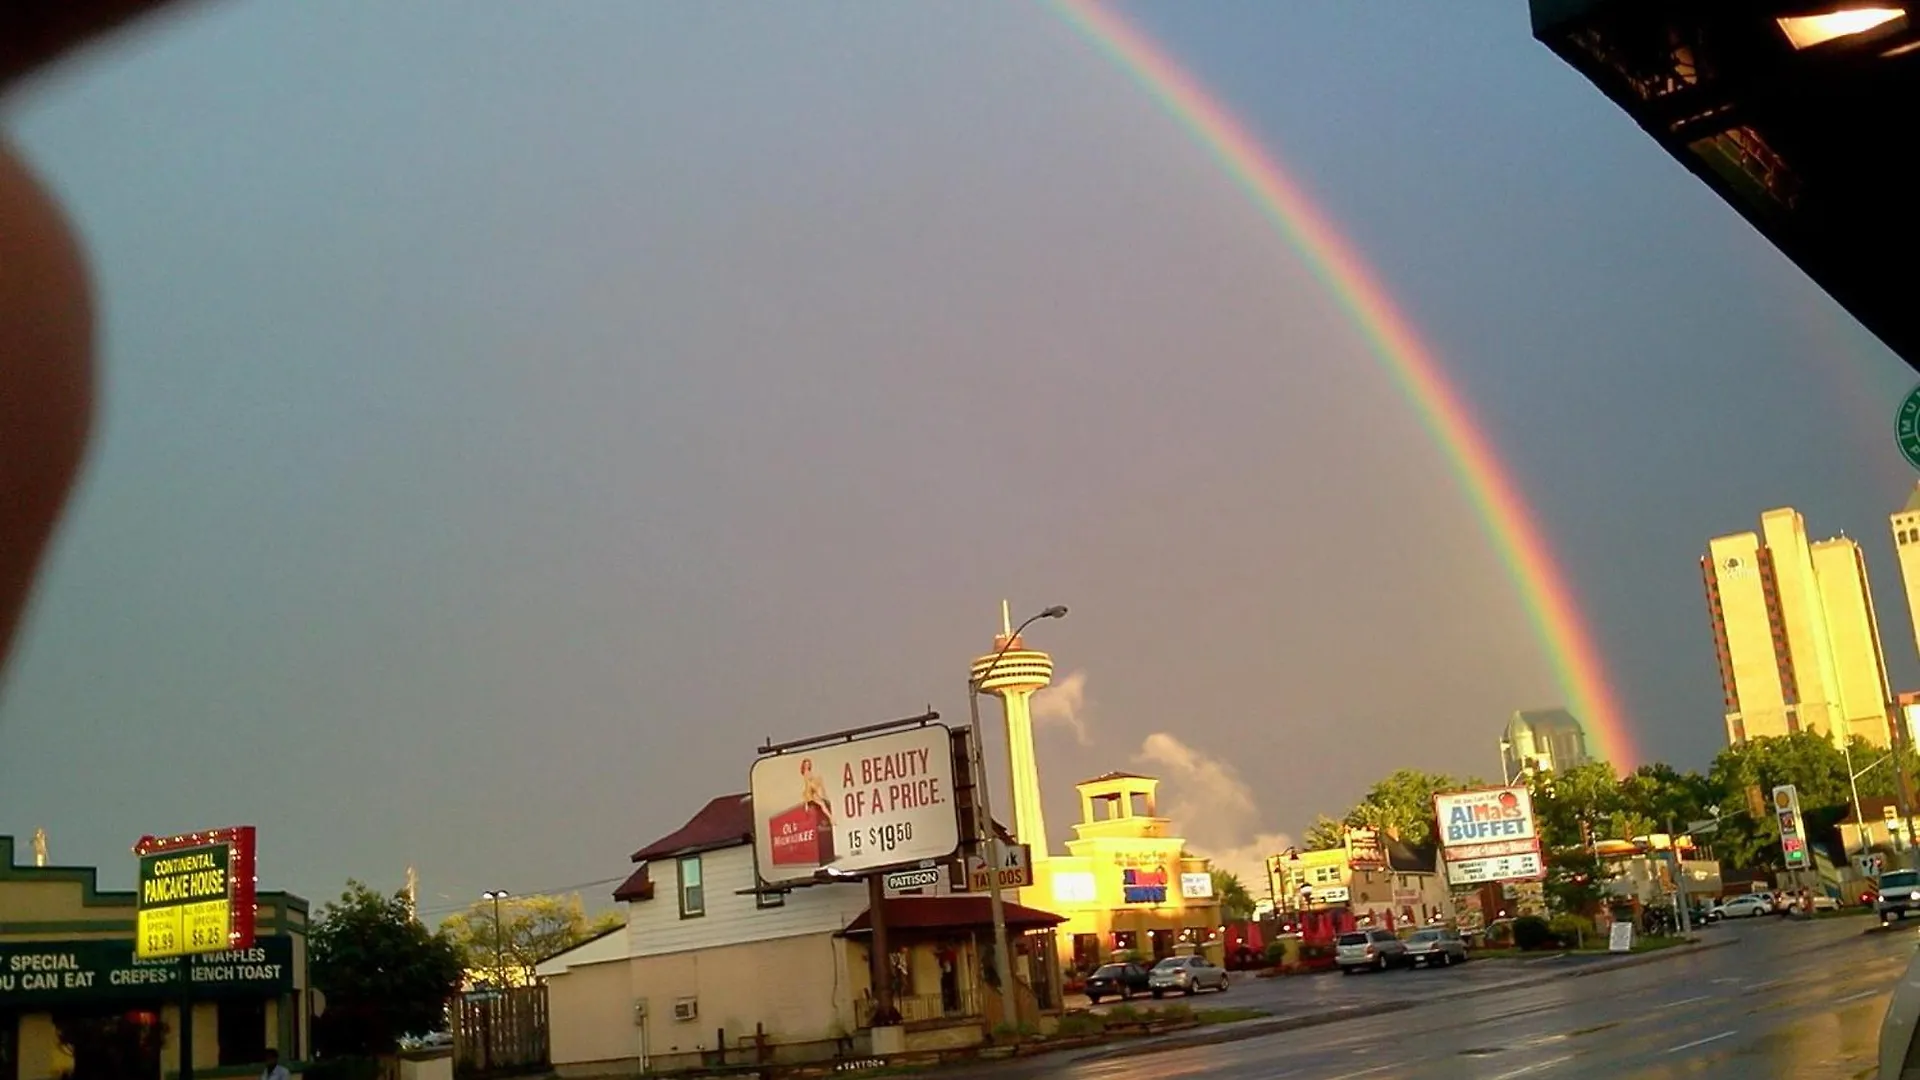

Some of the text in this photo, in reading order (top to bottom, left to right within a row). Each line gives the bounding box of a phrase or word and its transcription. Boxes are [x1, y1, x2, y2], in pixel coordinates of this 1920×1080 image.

[843, 748, 929, 788] A BEAUTY
[845, 778, 945, 818] OF A PRICE.
[849, 830, 861, 849] 15
[1448, 818, 1526, 841] BUFFET
[154, 853, 215, 876] CONTINENTAL
[145, 869, 224, 904] PANCAKE HOUSE
[890, 871, 937, 888] PATTISON
[192, 926, 220, 946] $6.25
[10, 953, 79, 971] SPECIAL
[22, 973, 58, 990] CAN
[65, 971, 95, 987] EAT
[110, 968, 167, 985] CREPES
[237, 964, 281, 980] TOAST
